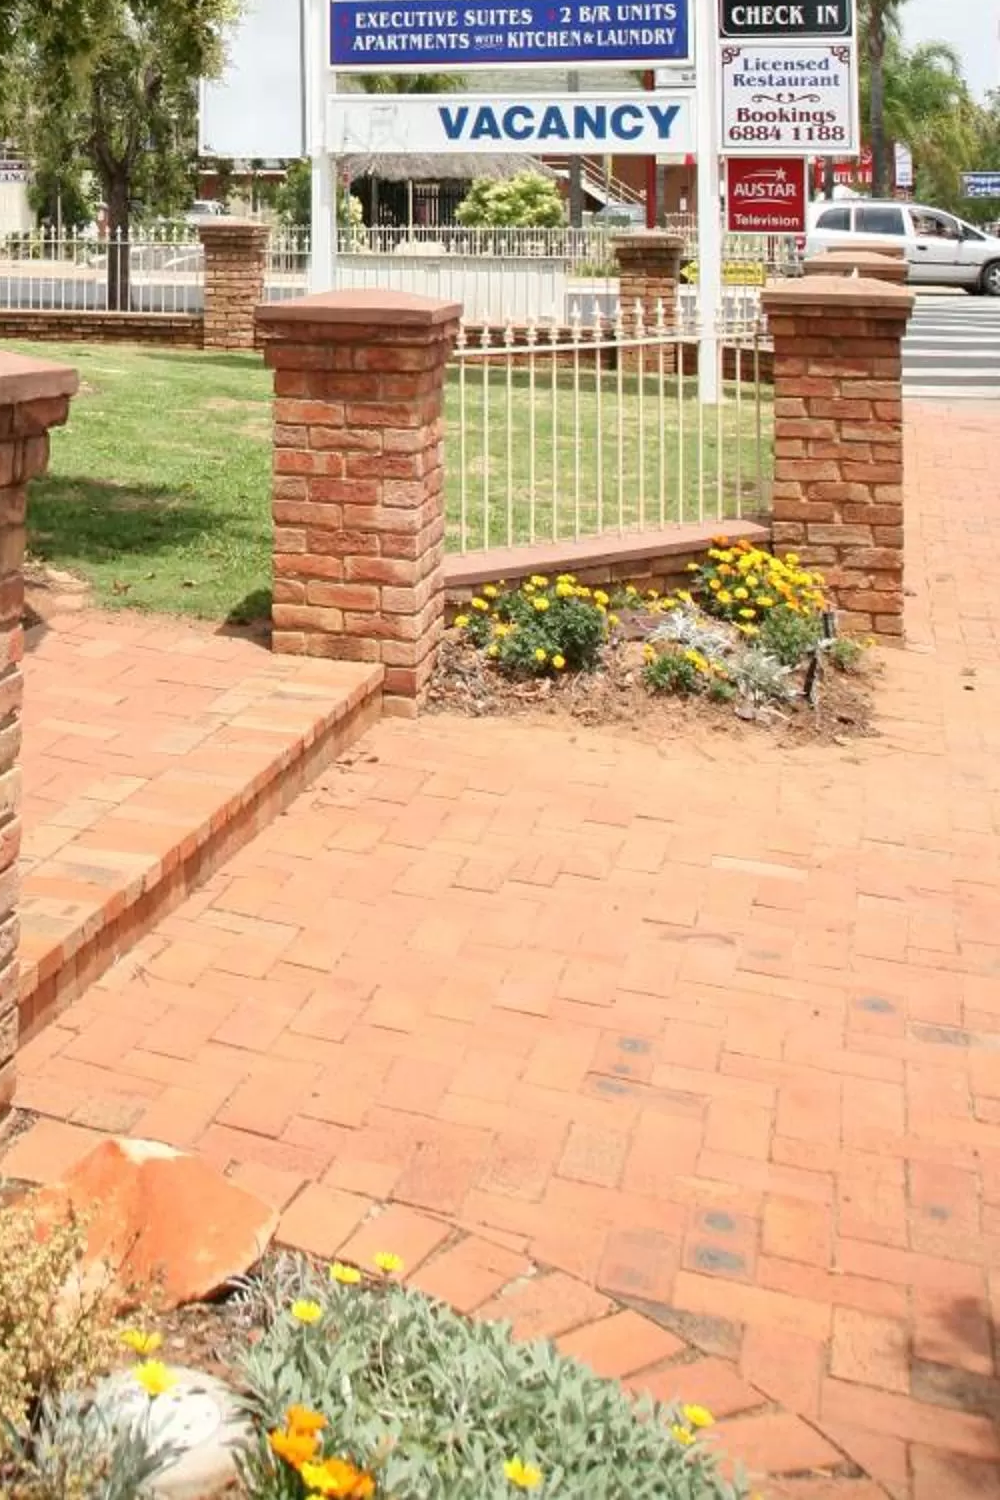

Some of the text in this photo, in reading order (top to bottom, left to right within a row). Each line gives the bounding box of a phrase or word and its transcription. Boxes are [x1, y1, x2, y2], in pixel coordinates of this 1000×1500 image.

[354, 3, 677, 29] EXECUTIVE SUITES 2 B/R UNITS
[731, 5, 839, 26] CHECK IN
[353, 33, 470, 51] APARTMENTS
[507, 30, 581, 49] KITCHEN
[597, 28, 677, 46] LAUNDRY
[743, 57, 829, 72] Licensed
[732, 73, 840, 88] Restaurant
[438, 105, 681, 141] VACANCY
[736, 108, 837, 126] Bookings
[729, 125, 845, 141] 6884 1188
[733, 182, 797, 197] AUSTAR
[733, 212, 800, 227] Television
